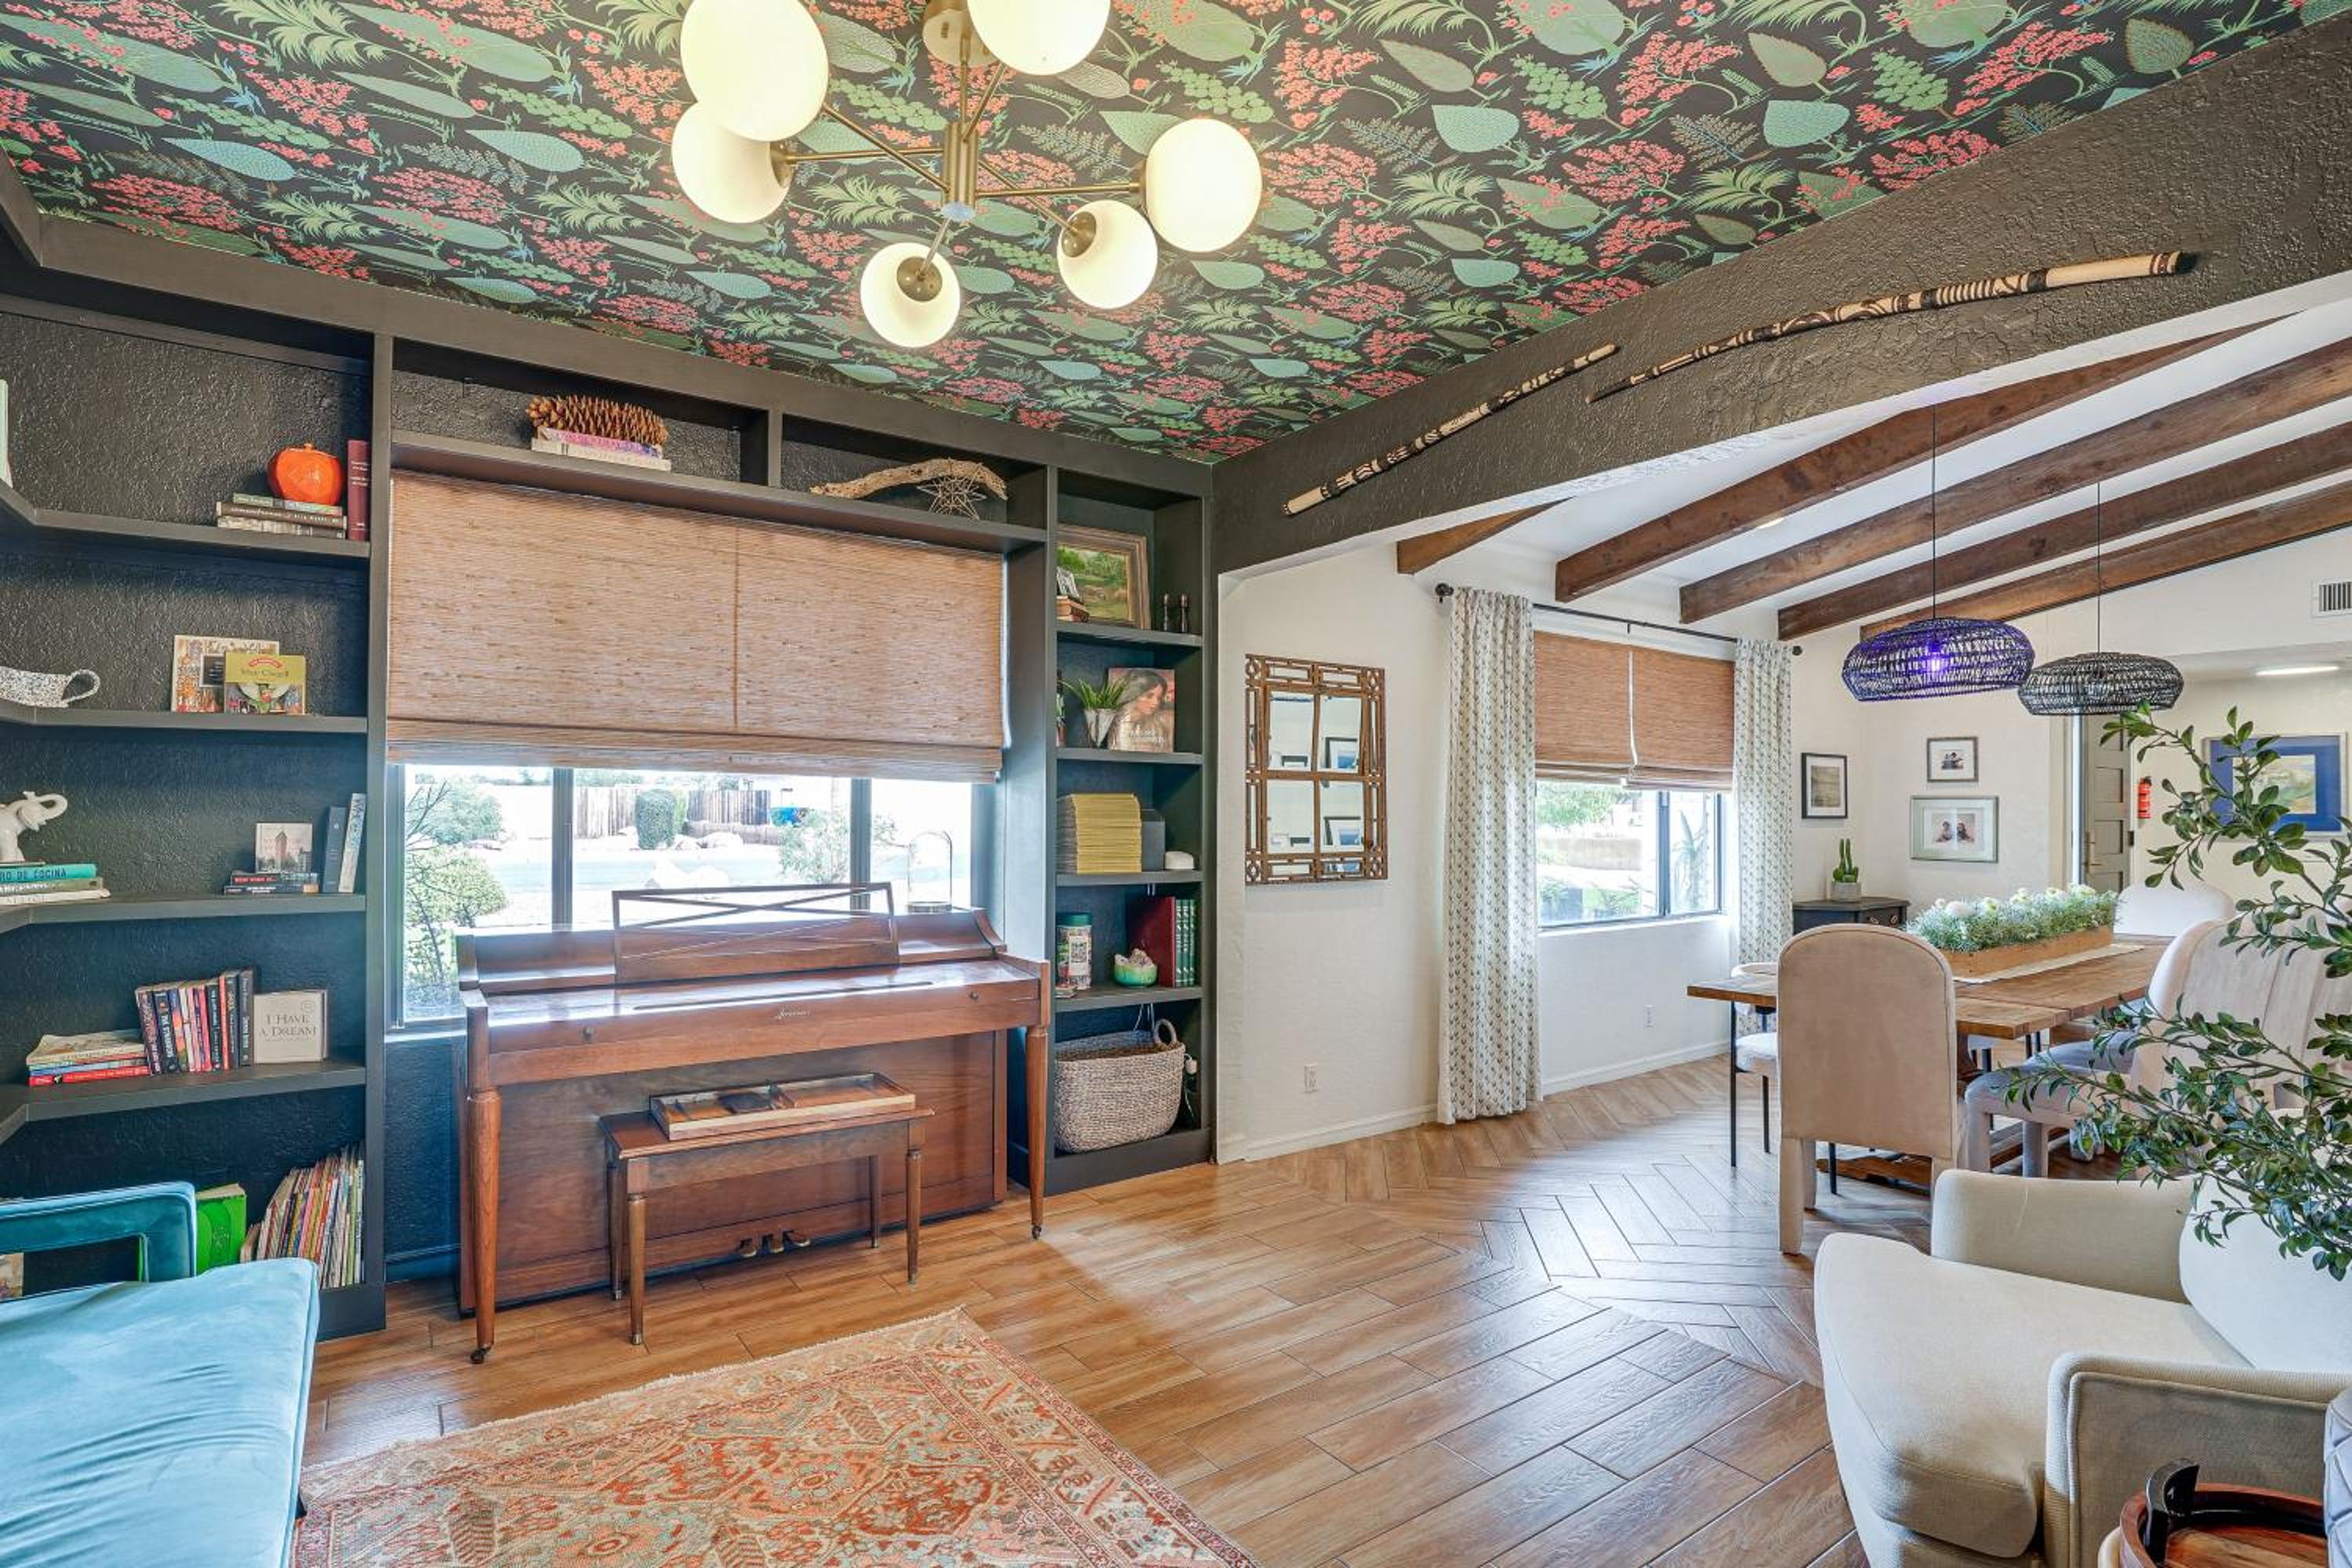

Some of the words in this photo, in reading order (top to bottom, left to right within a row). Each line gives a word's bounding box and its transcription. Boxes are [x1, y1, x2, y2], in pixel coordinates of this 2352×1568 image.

[34, 867, 69, 879] COCINA
[276, 1014, 310, 1025] HAVE
[270, 1026, 317, 1036] DREAM
